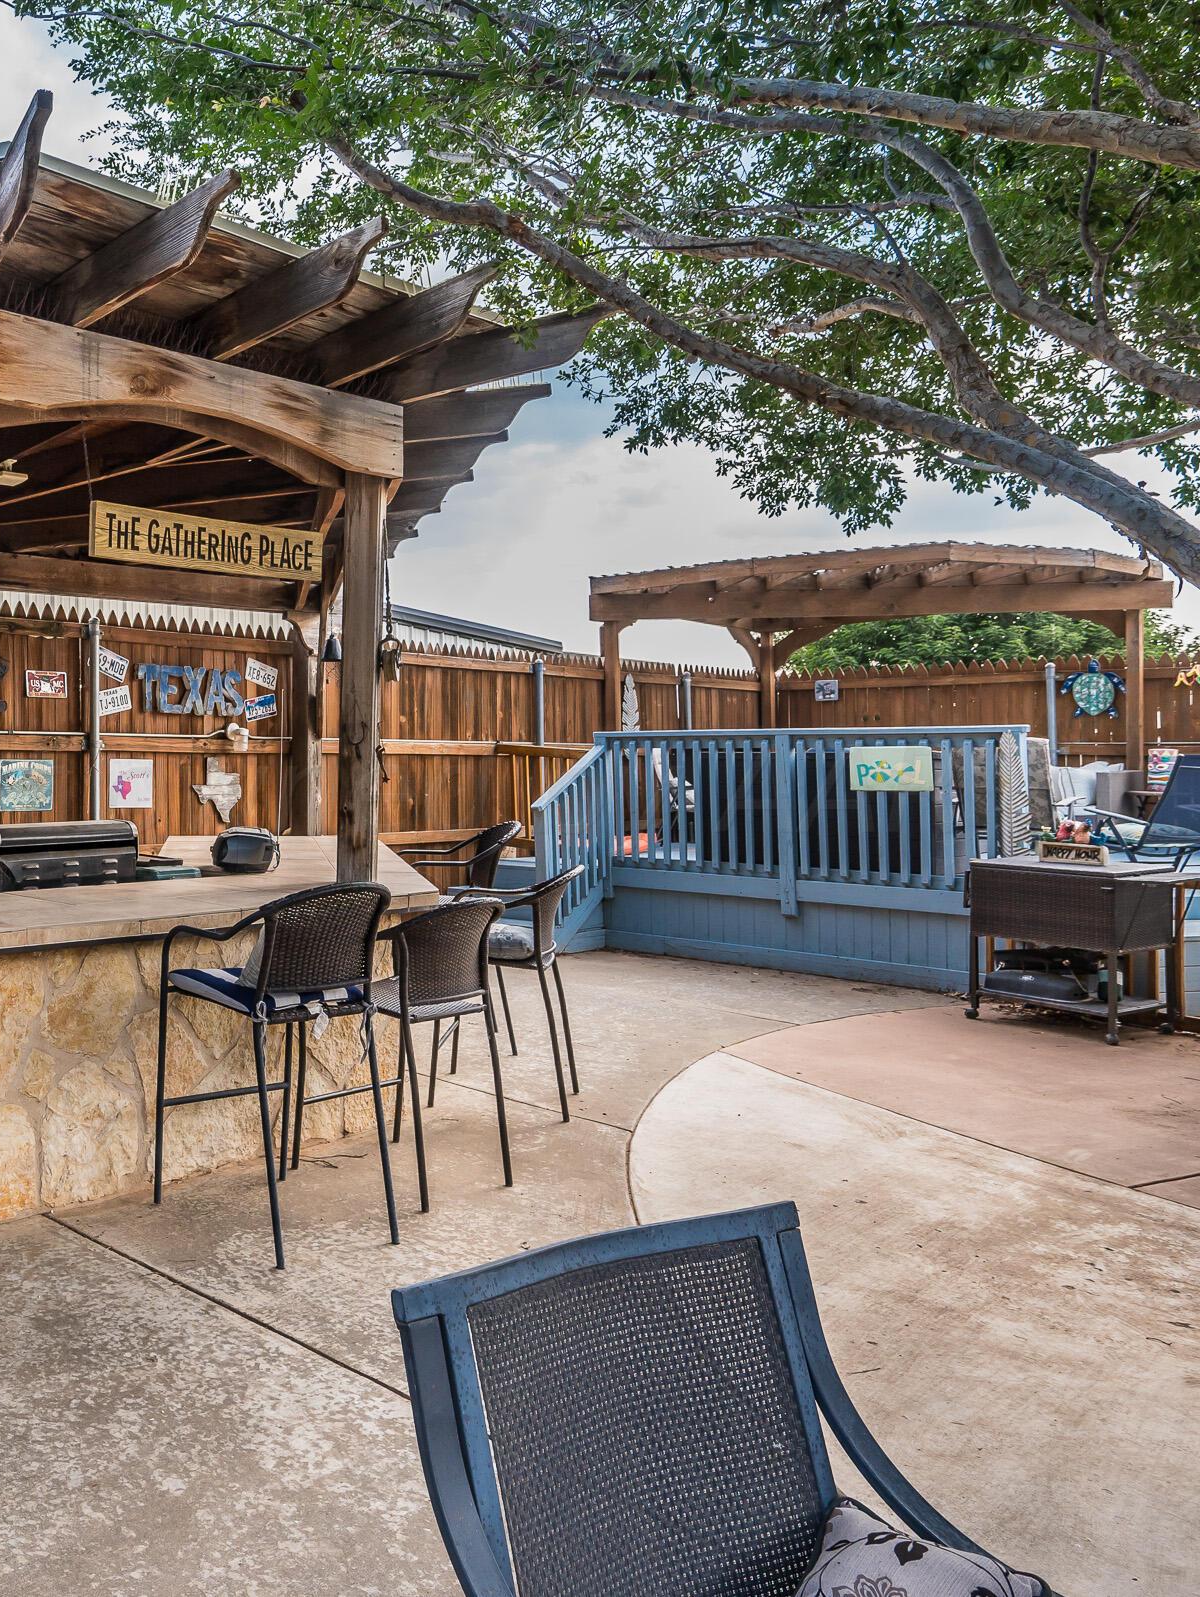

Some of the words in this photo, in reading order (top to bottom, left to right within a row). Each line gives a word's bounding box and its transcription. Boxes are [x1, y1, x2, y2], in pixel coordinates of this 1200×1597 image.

[106, 513, 140, 551] THE
[147, 519, 252, 565] GATHERING
[259, 534, 314, 571] PLACE
[103, 689, 118, 697] TEXAS
[136, 664, 245, 716] TEXAS
[1046, 846, 1073, 860] HAPPY
[1075, 848, 1101, 862] HOUR
